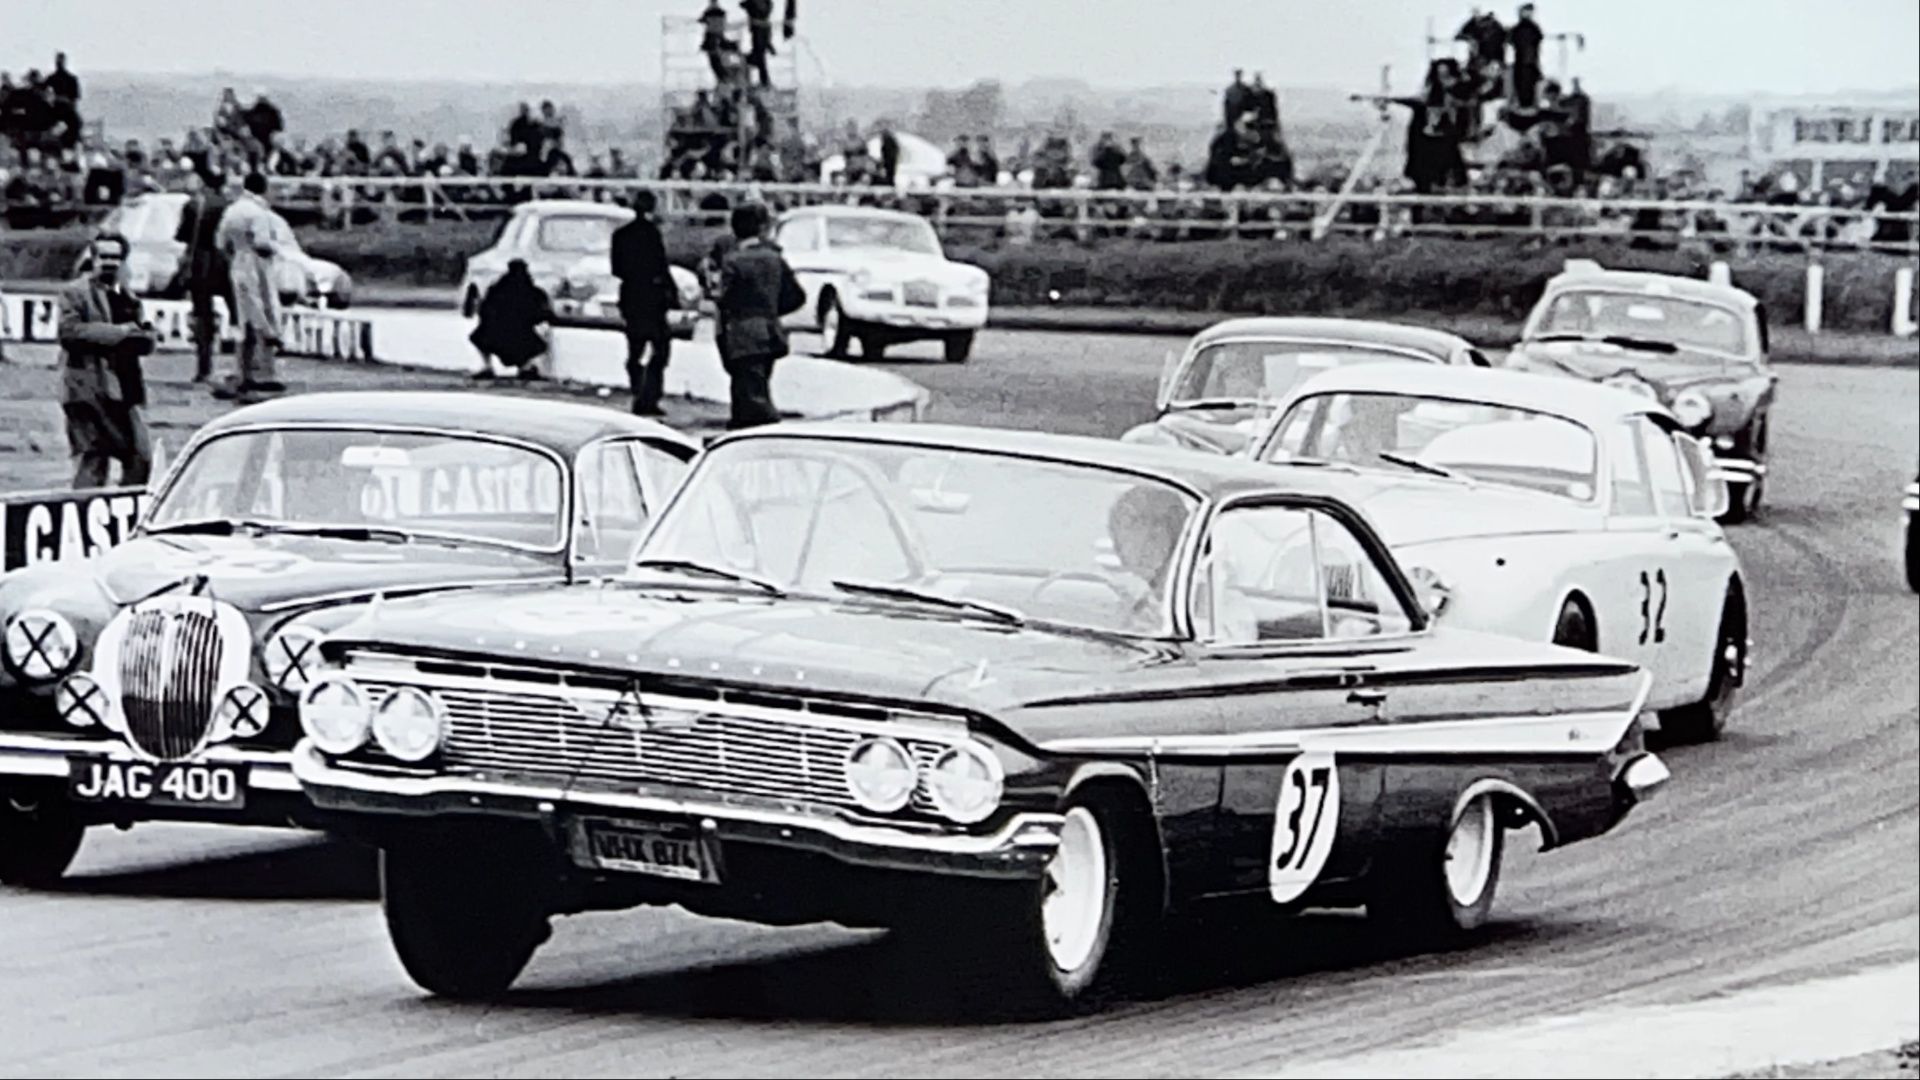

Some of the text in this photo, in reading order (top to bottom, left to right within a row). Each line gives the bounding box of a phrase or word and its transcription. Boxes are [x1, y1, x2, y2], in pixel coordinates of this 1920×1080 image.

[1639, 568, 1667, 646] 32
[76, 764, 236, 801] JAG 400
[1277, 767, 1331, 871] 37
